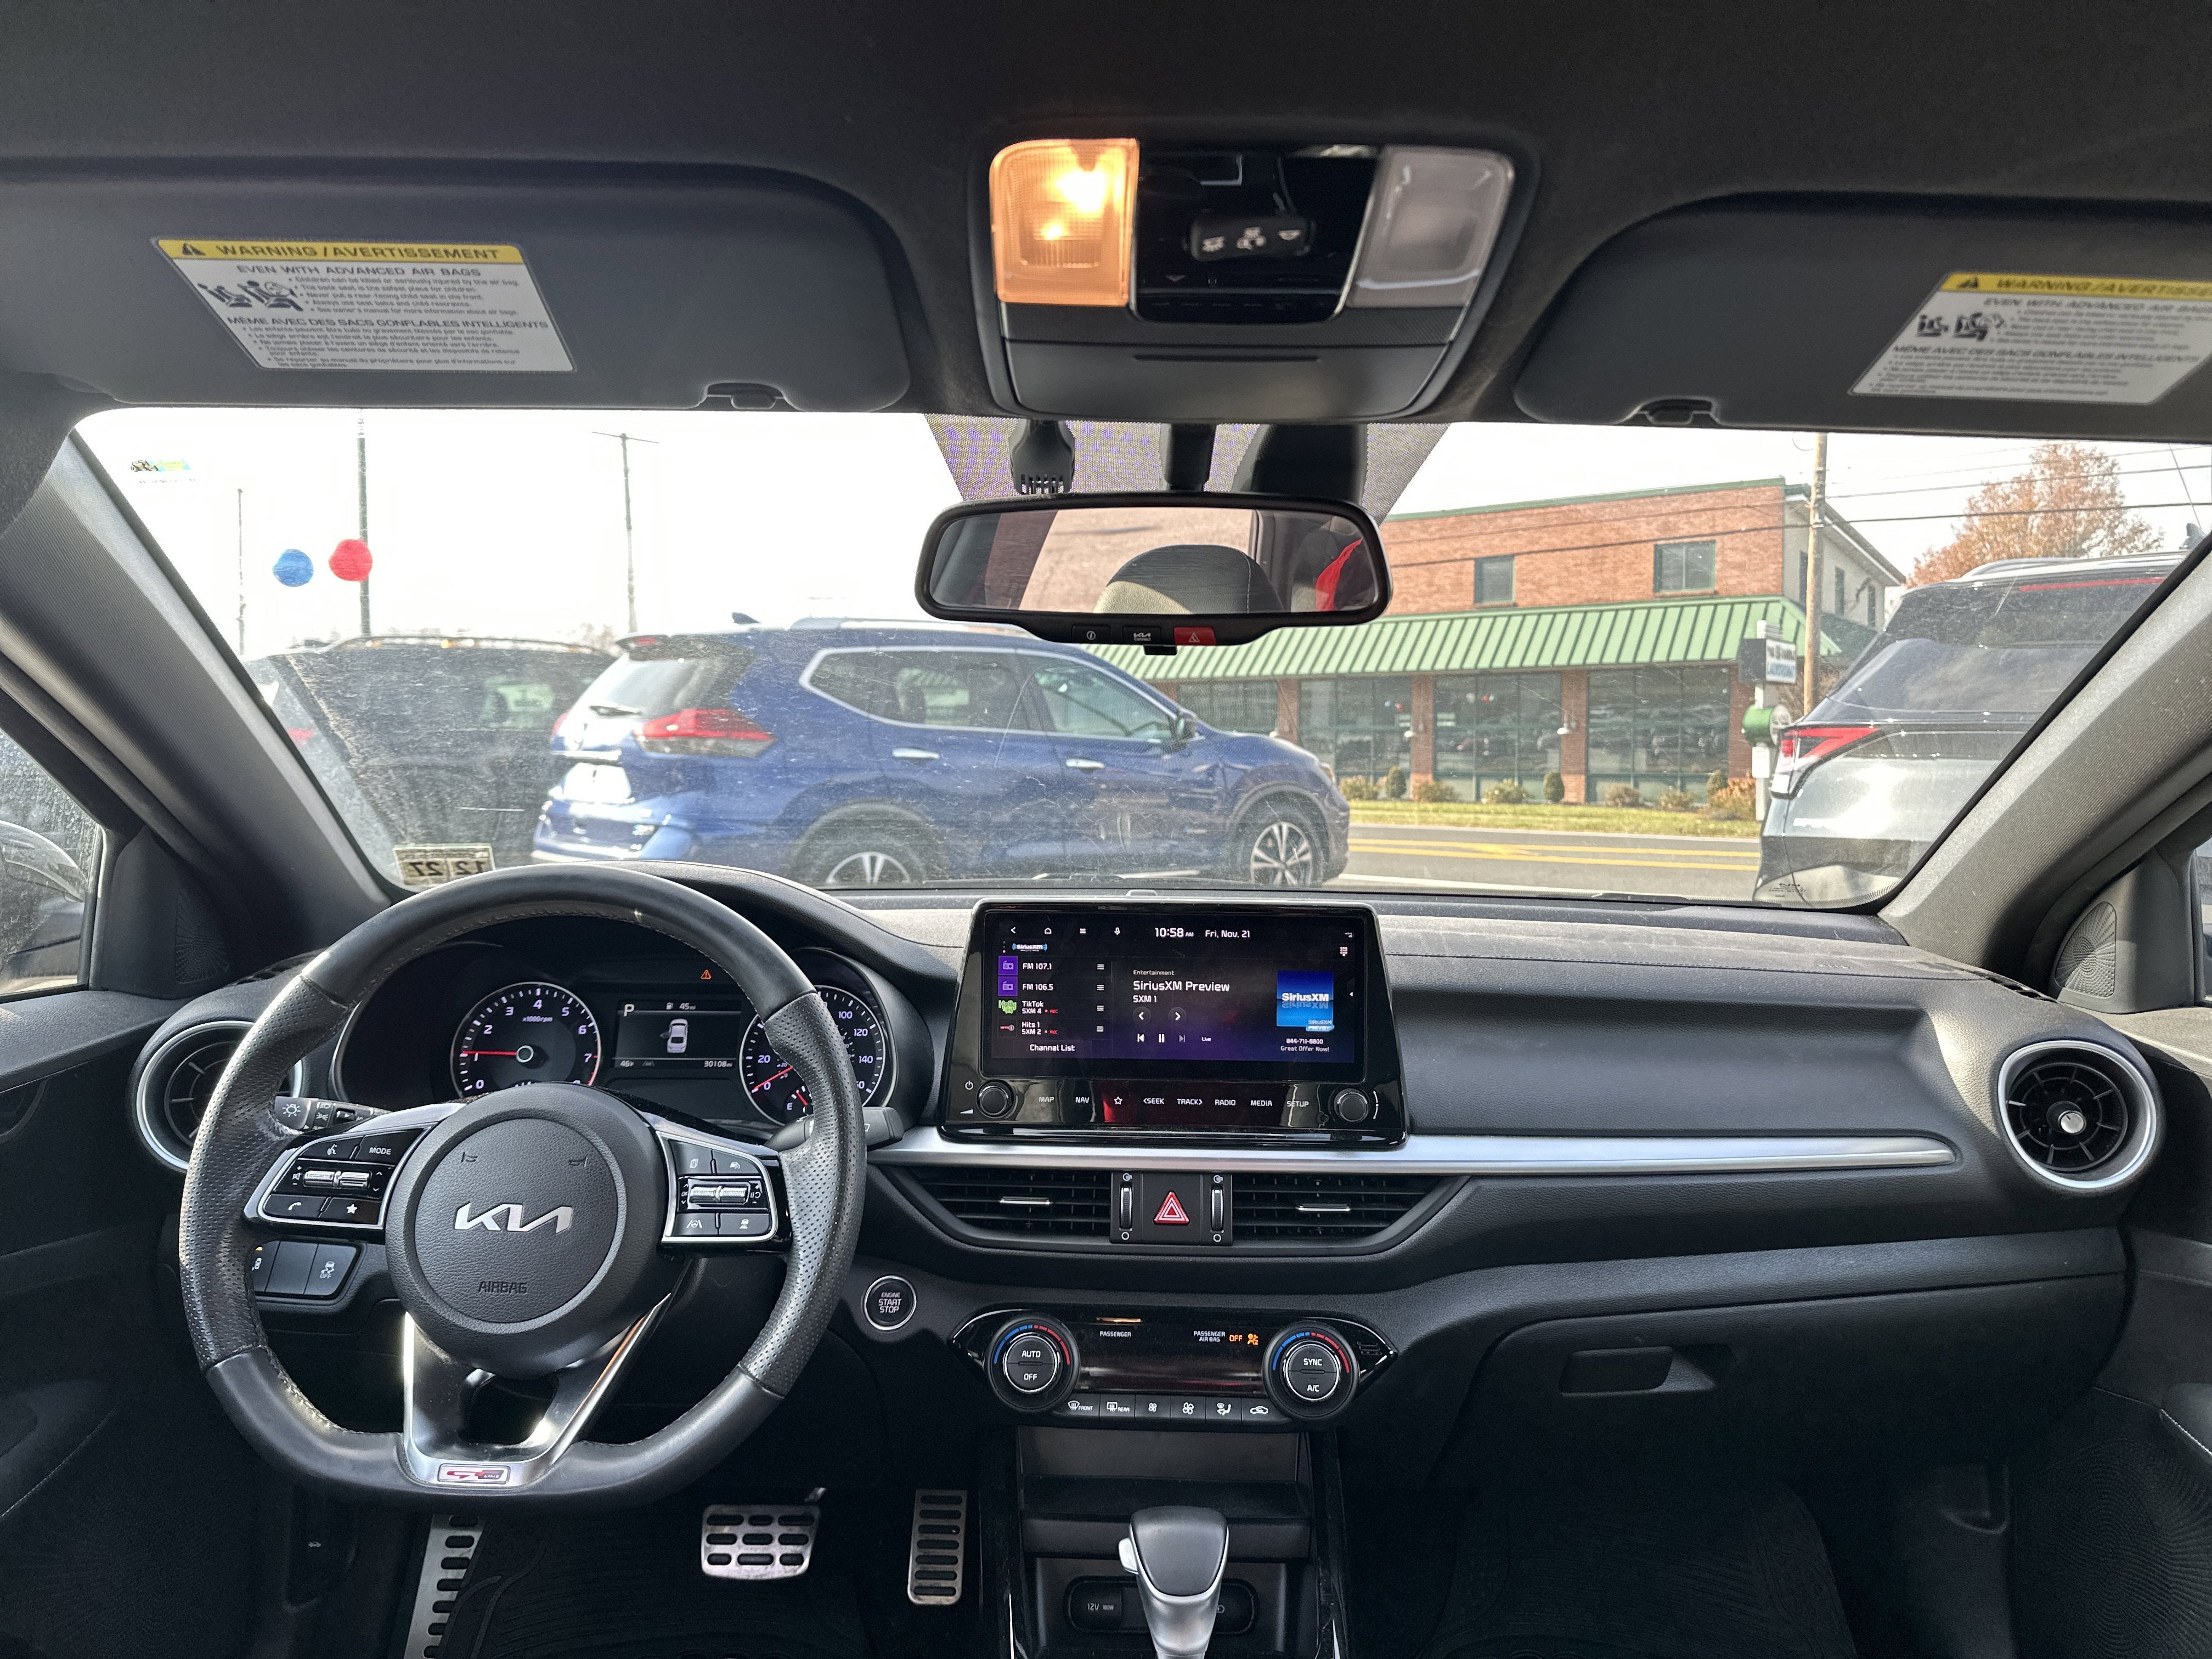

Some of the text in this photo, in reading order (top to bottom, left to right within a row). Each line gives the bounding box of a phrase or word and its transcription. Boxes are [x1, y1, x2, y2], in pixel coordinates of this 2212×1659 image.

[216, 245, 498, 259] WARNING AVERTISSEMENT
[236, 265, 481, 276] EVEN WITH ADVANCED AIR BAGS
[1155, 927, 1184, 937] 10:58
[1133, 980, 1230, 991] SiriusXM Preview
[1282, 992, 1329, 1001] SiriusXM
[533, 999, 543, 1009] 4
[505, 1006, 514, 1015] 3
[561, 1007, 569, 1017] 5
[623, 1003, 635, 1017] P
[838, 1011, 853, 1019] 100
[483, 1024, 493, 1034] 2
[578, 1025, 586, 1035] 6
[854, 1028, 868, 1036] 120
[584, 1053, 592, 1063] 7
[758, 1054, 771, 1063] 20
[859, 1055, 873, 1064] 140
[476, 1079, 484, 1089] 0
[763, 1081, 771, 1091] 0
[786, 1102, 793, 1110] E
[369, 1147, 392, 1155] MODE
[454, 1202, 574, 1234] KIA
[478, 1280, 528, 1294] AIRBAG
[1303, 1358, 1323, 1366] SYNC
[1307, 1384, 1320, 1392] A/C
